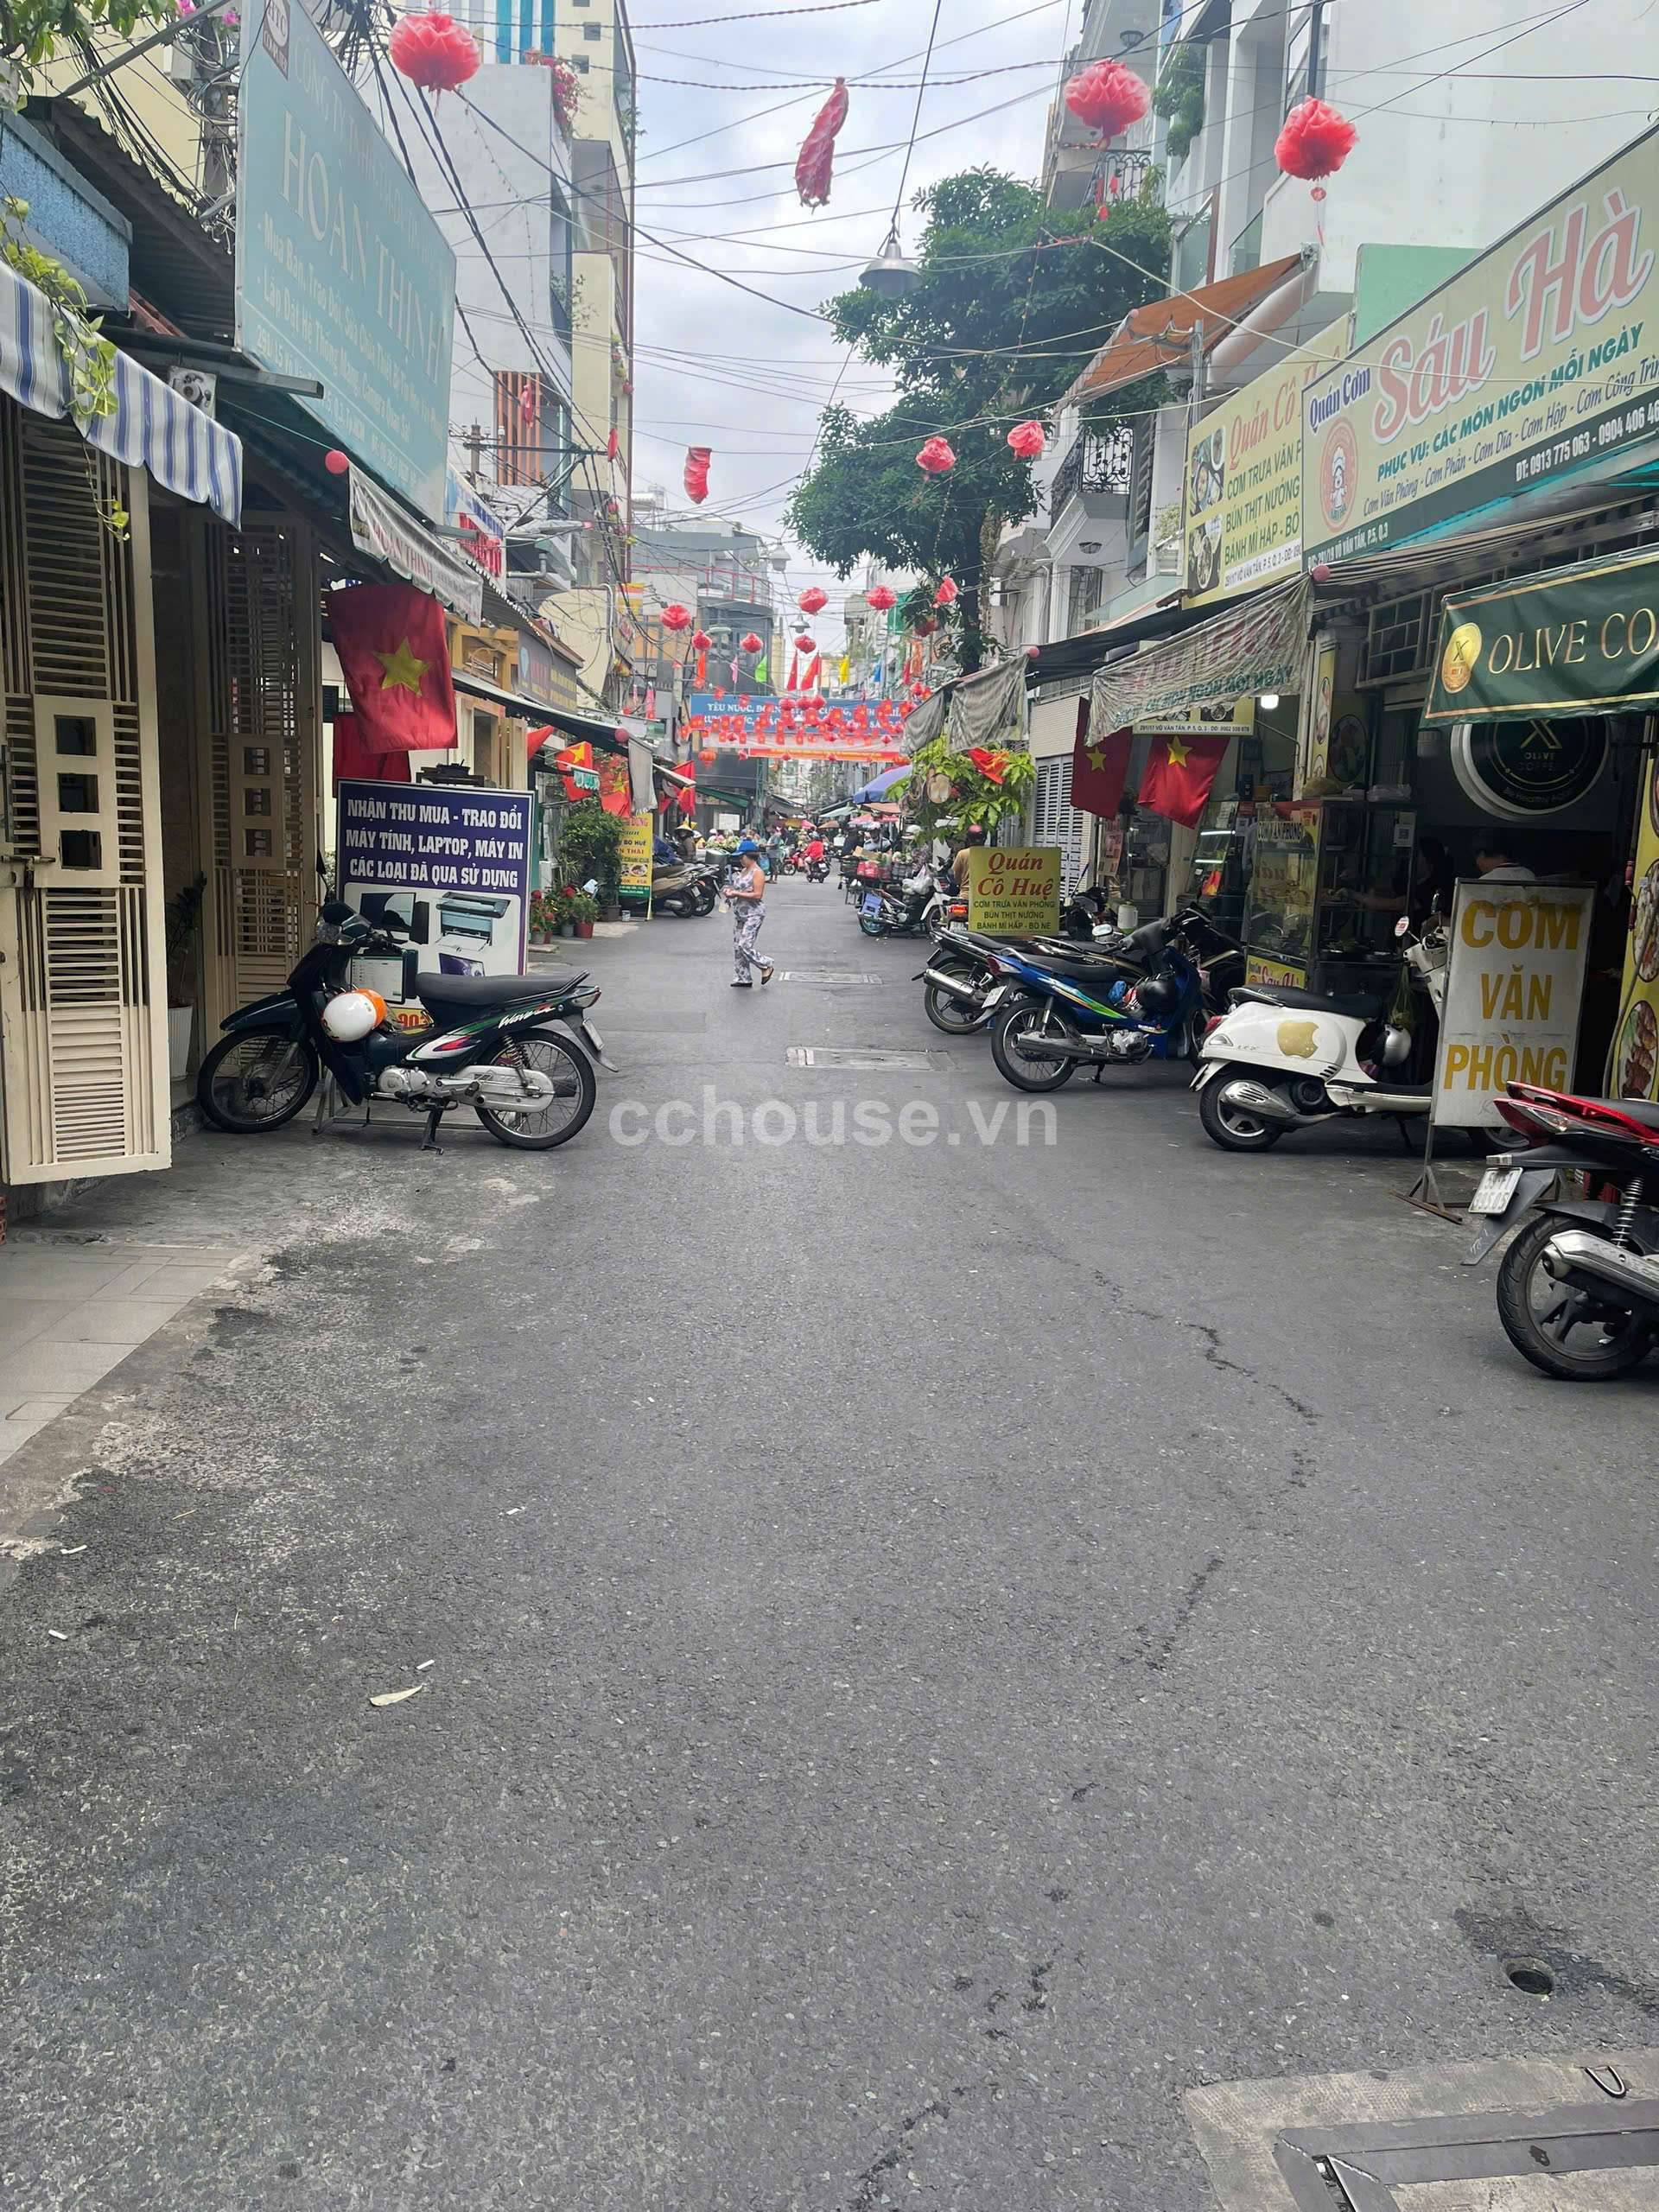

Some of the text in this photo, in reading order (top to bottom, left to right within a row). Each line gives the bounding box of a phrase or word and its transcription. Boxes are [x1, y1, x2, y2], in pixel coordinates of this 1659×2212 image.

[276, 105, 368, 289] HOÀN
[1505, 187, 1654, 361] Hà
[1310, 385, 1339, 433] Quán
[1343, 366, 1370, 406] Cơm
[1373, 307, 1497, 443] Sáu
[1377, 451, 1407, 482] PHỤC
[1433, 423, 1458, 453] CÁC
[1460, 404, 1494, 438] MÓN
[1497, 375, 1546, 420] NGON
[1548, 348, 1585, 392] MỖI
[1587, 321, 1643, 372] NGÀY
[1230, 400, 1269, 470] Quán
[1274, 378, 1296, 432] Cô
[1530, 448, 1551, 475] 0913
[1554, 440, 1570, 466] 775
[1572, 431, 1590, 457] 063
[1599, 416, 1623, 445] 0904
[1625, 406, 1645, 434] 406
[1247, 459, 1273, 490] TRƯA
[1488, 607, 1659, 675] OLIVE CO
[347, 798, 522, 830] NHẬN THU MUA TRAO ĐỔI
[346, 827, 524, 860] MÁY TÍNH, LAPTOP, MÁY IN
[988, 852, 1043, 874] Quán
[350, 856, 518, 890] CÁC LOẠI ĐÃ QUA SỬ DỤNG
[977, 878, 1054, 900] Cô Huệ
[1460, 897, 1585, 950] CƠM
[1480, 964, 1552, 1021] VĂN
[1444, 1034, 1568, 1092] PHÒNG
